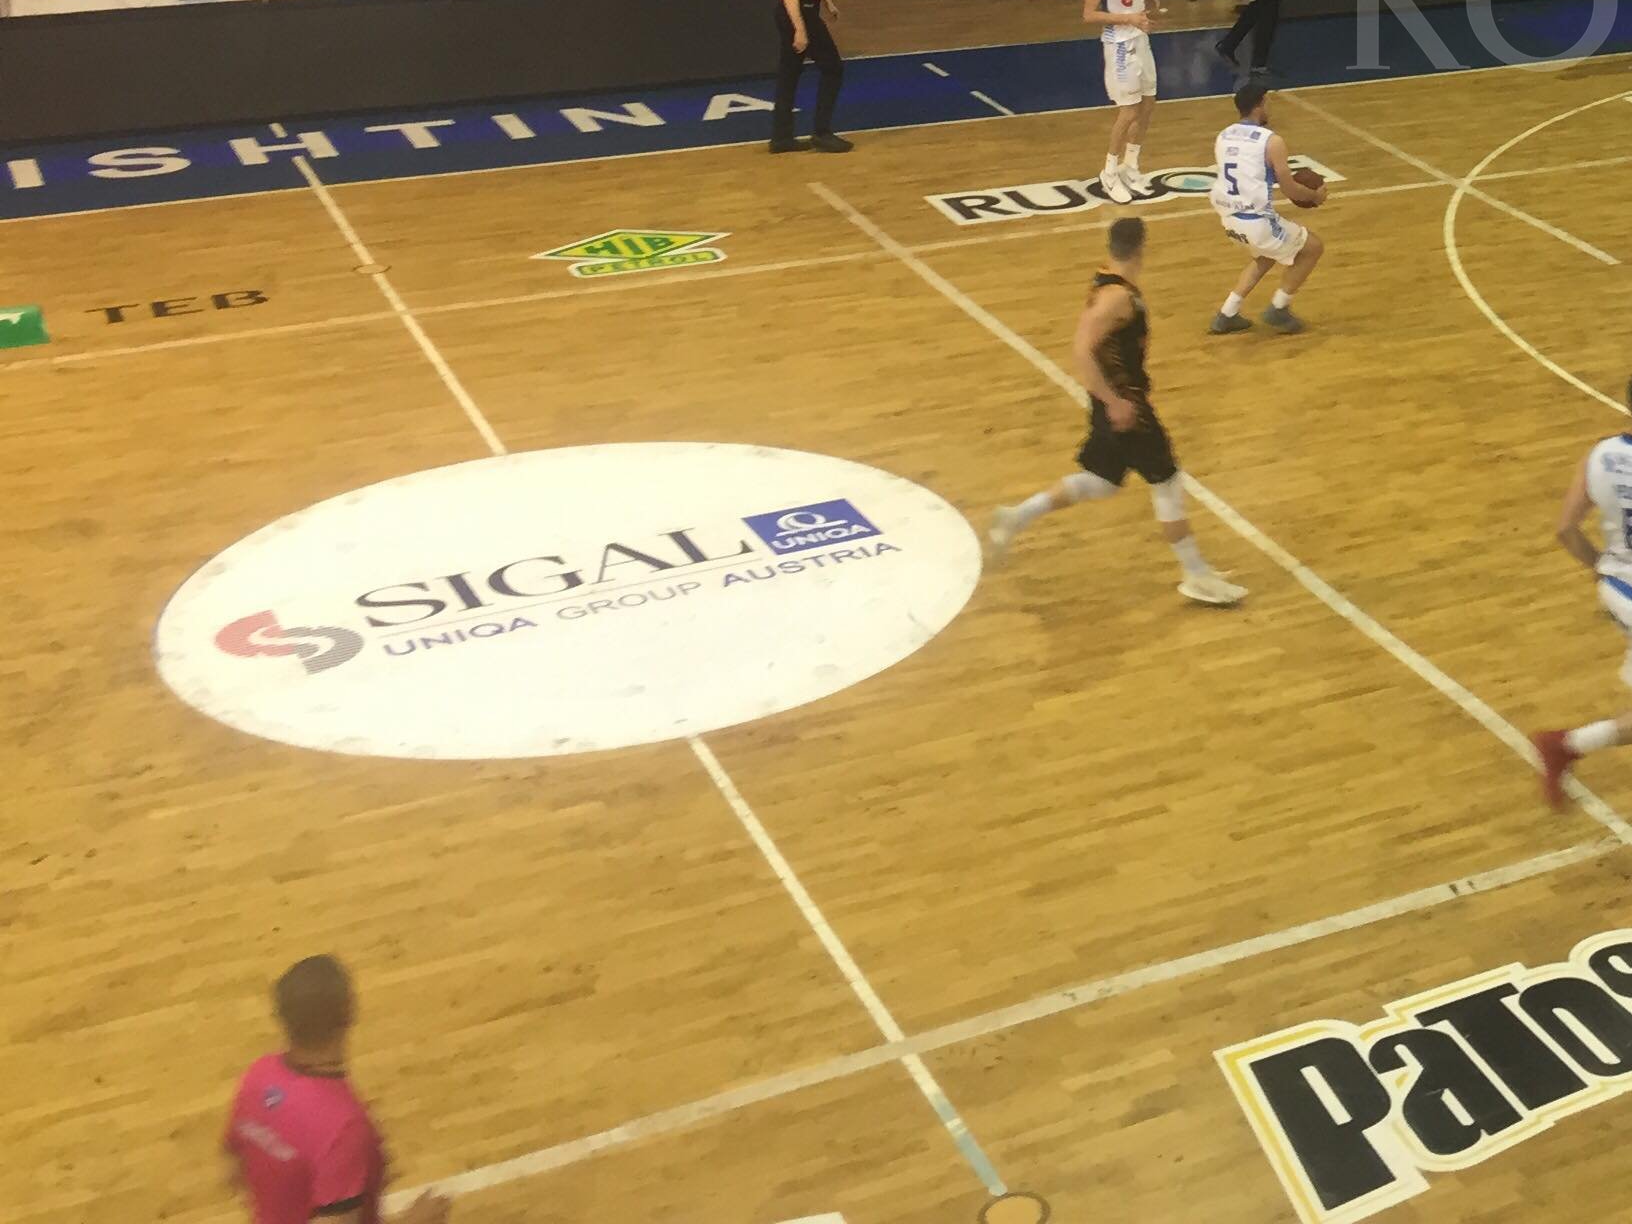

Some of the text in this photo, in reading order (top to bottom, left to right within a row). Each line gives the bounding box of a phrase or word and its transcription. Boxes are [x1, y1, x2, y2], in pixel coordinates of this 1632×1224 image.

[1224, 163, 1240, 195] 5
[85, 290, 269, 324] TEB
[771, 523, 871, 550] UNIQA
[355, 527, 754, 627] SIGAL
[384, 542, 902, 656] UNIQA GROUP AUSTRIA
